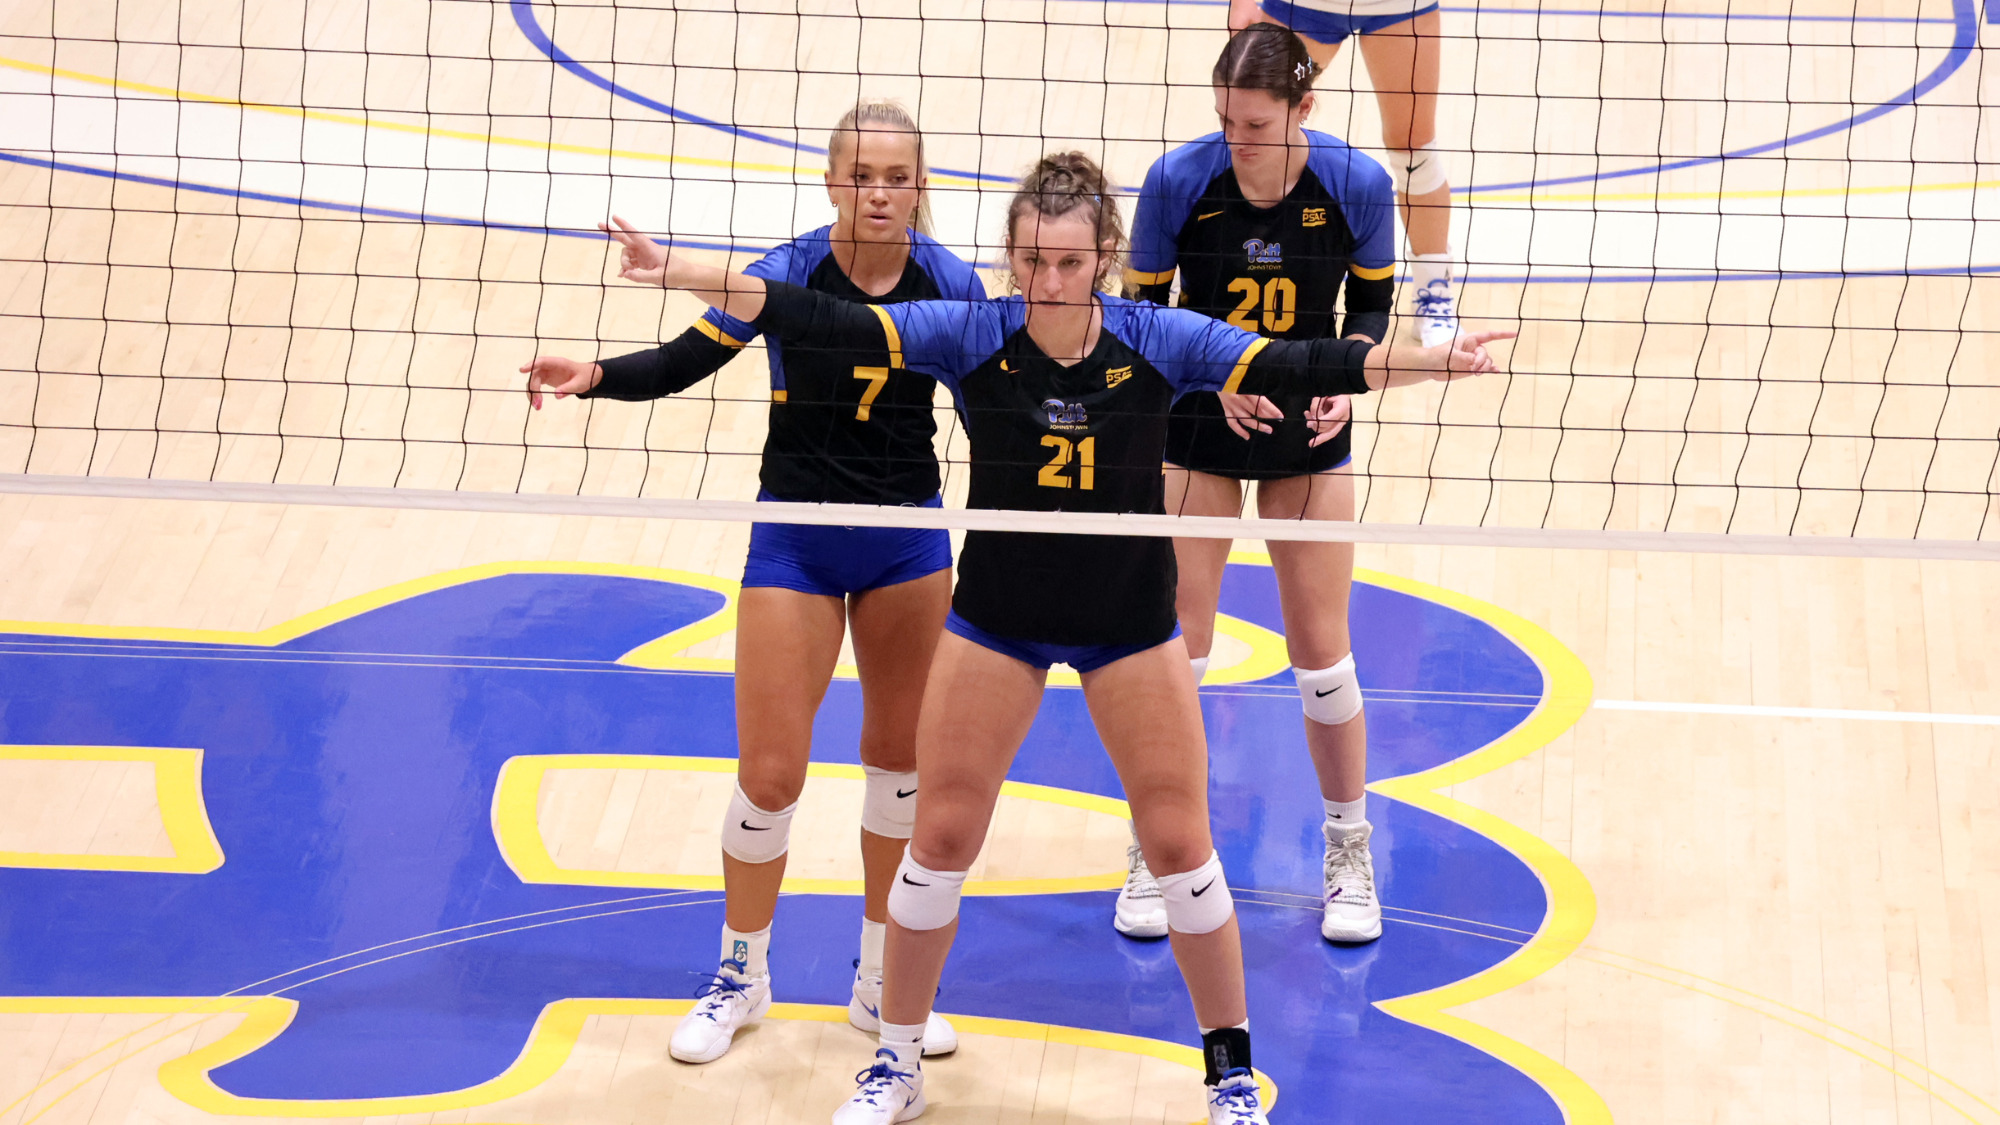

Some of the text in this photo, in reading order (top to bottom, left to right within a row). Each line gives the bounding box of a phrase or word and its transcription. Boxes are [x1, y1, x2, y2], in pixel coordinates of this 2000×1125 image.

[1243, 239, 1282, 263] Pitt
[1226, 277, 1297, 332] 20
[853, 366, 889, 421] 7
[1042, 399, 1087, 423] Pitt
[1038, 435, 1095, 490] 21
